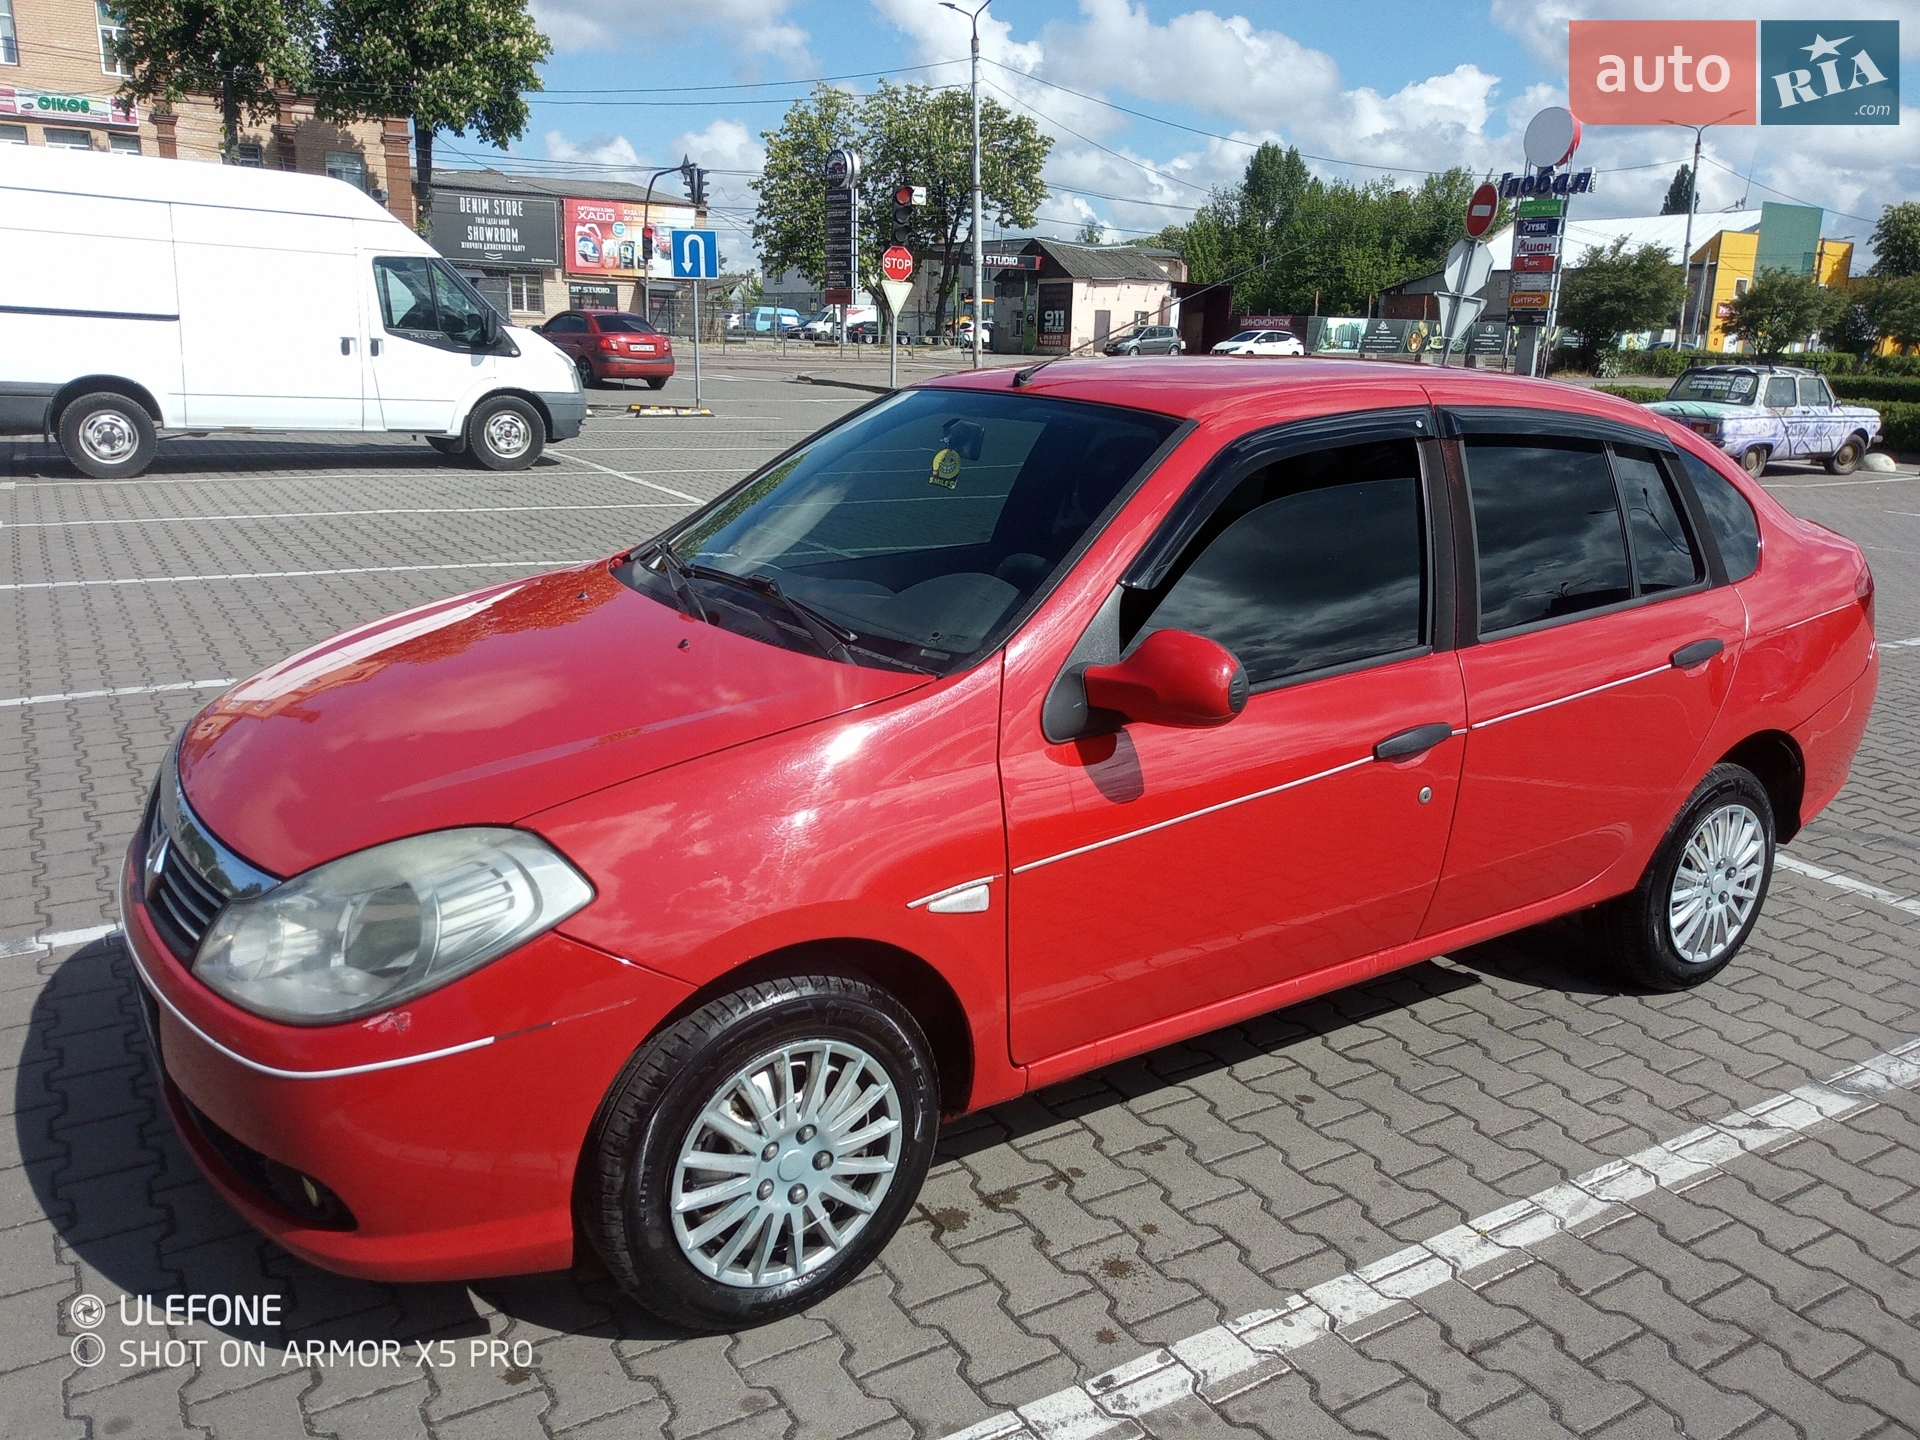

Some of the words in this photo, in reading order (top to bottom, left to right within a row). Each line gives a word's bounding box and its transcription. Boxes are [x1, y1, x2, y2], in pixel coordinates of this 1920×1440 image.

[38, 96, 90, 113] OIKOS
[459, 197, 490, 215] DENIM
[494, 199, 524, 217] STORE
[577, 211, 615, 222] XADO
[1527, 223, 1546, 231] JYSK
[467, 225, 519, 244] SHOWROOM
[884, 257, 911, 271] STOP
[987, 255, 1018, 266] STUDIO
[1044, 310, 1065, 326] 911
[1240, 318, 1291, 327] ШИНОМОНТАЖ
[1044, 325, 1065, 333] STUDIO
[928, 476, 955, 489] SMILES
